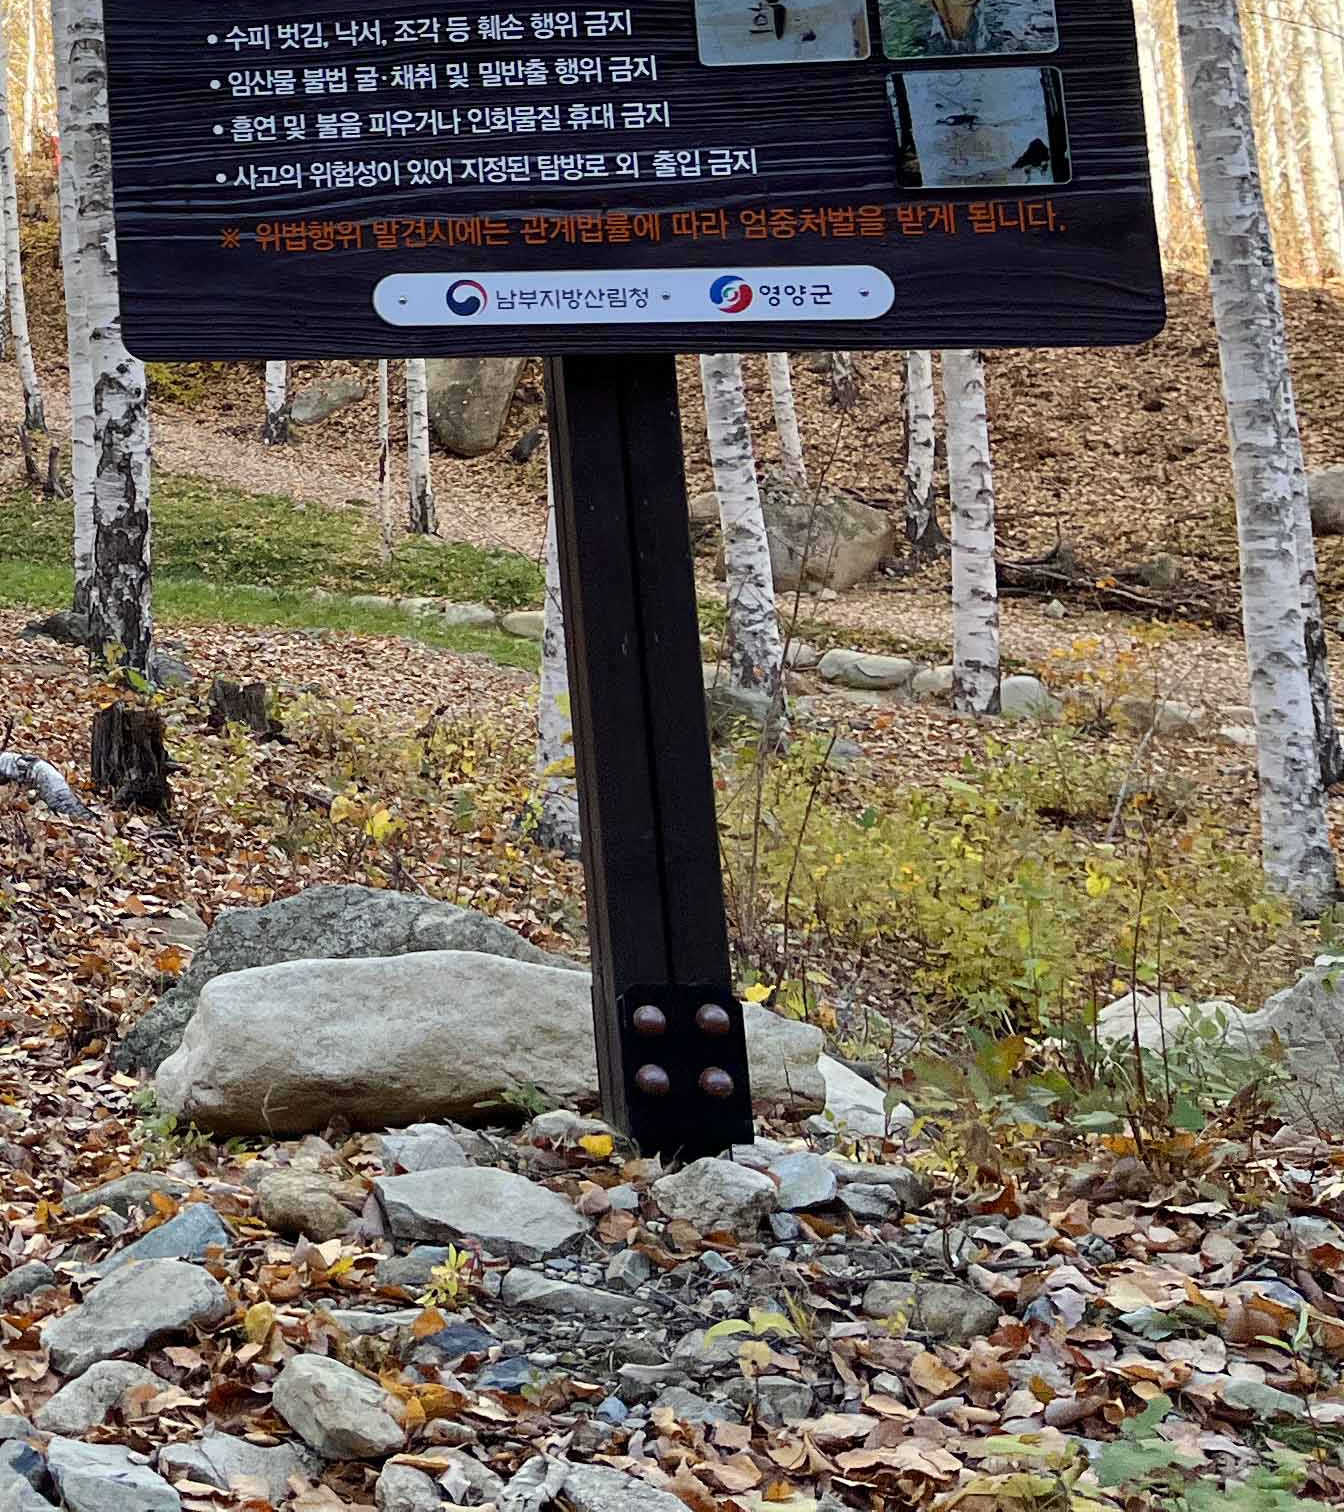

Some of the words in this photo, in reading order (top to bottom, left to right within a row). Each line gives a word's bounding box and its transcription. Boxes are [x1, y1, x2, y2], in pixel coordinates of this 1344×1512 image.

[224, 24, 270, 51] 수피
[277, 22, 329, 49] 벗김,
[335, 19, 388, 48] 낙서,
[393, 17, 440, 43] 조각
[446, 16, 471, 42] 등
[477, 13, 524, 41] 훼손
[530, 10, 578, 38] 행위
[583, 9, 632, 36] 금지
[228, 68, 296, 97] 임산물
[302, 66, 348, 94] 불법
[445, 62, 470, 88] 및
[478, 59, 550, 87] 밀반출
[554, 56, 602, 85] 행위
[608, 54, 658, 82] 금지
[230, 115, 276, 142] 흡연
[283, 113, 306, 140] 및
[315, 111, 363, 139] 불을
[368, 108, 461, 137] 피우거나
[467, 105, 562, 134] 인화물질
[567, 102, 615, 130] 휴대
[621, 101, 671, 128] 금지
[233, 163, 302, 190] 사고의
[309, 159, 400, 188] 위험성이
[407, 157, 453, 185] 있어
[462, 155, 531, 184] 지정된
[537, 153, 609, 181] 탐방로
[615, 151, 640, 178] 외
[652, 149, 702, 178] 출입
[707, 147, 758, 175] 금지
[255, 219, 362, 253] 위법행위
[372, 215, 513, 250] 발견시에는
[520, 211, 661, 245] 관계법률에
[672, 208, 728, 241] 따라
[739, 204, 885, 240] 엄중처벌을
[897, 203, 956, 236] 받게
[967, 199, 1067, 234] 됩니다.
[495, 286, 650, 312] 남부지방산림청
[759, 283, 833, 307] 영양군
